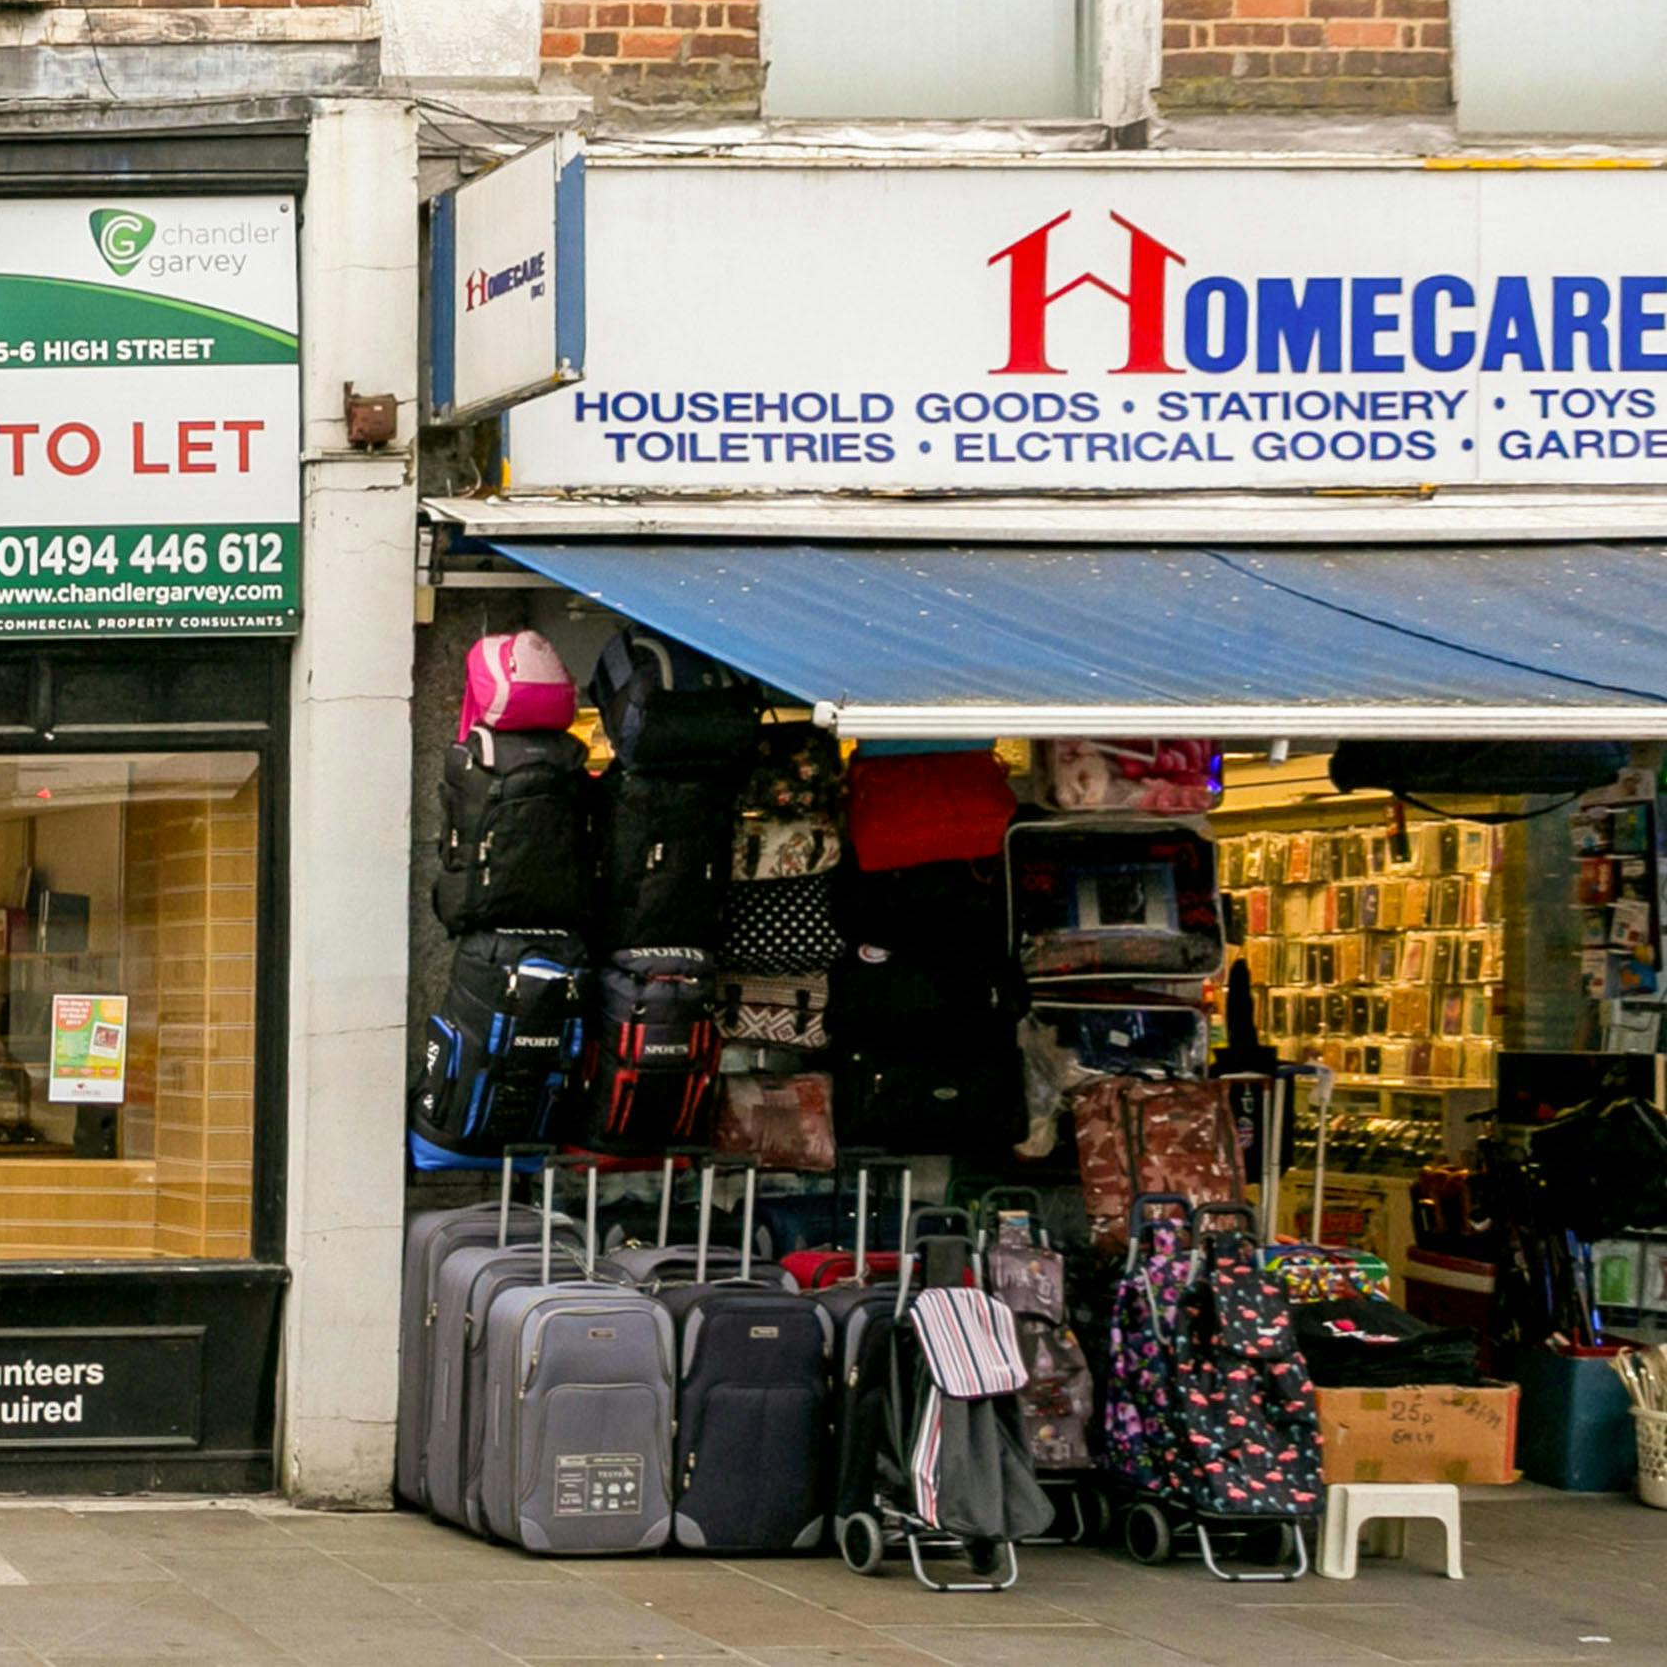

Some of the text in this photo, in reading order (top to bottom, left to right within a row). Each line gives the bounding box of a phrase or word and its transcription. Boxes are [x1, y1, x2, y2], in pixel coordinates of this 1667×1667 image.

[162, 222, 279, 245] chandler
[149, 254, 246, 277] garvey
[988, 210, 1667, 374] HOMECARE
[44, 341, 107, 361] HIGH
[116, 339, 214, 360] STREET
[576, 388, 1655, 423] HOUSEHOLD GOODS STATIONERY TOYS
[133, 421, 264, 474] LET
[604, 432, 894, 462] TOILETRIES
[955, 432, 1234, 462] ELCTRICAL
[1253, 431, 1436, 461] GOODS
[129, 535, 207, 574] 446
[218, 534, 283, 572] 612
[98, 616, 173, 629] PROPERTY
[180, 615, 283, 628] CONSULTANTS
[629, 947, 704, 962] SPORTS
[514, 1036, 560, 1047] SPORTS
